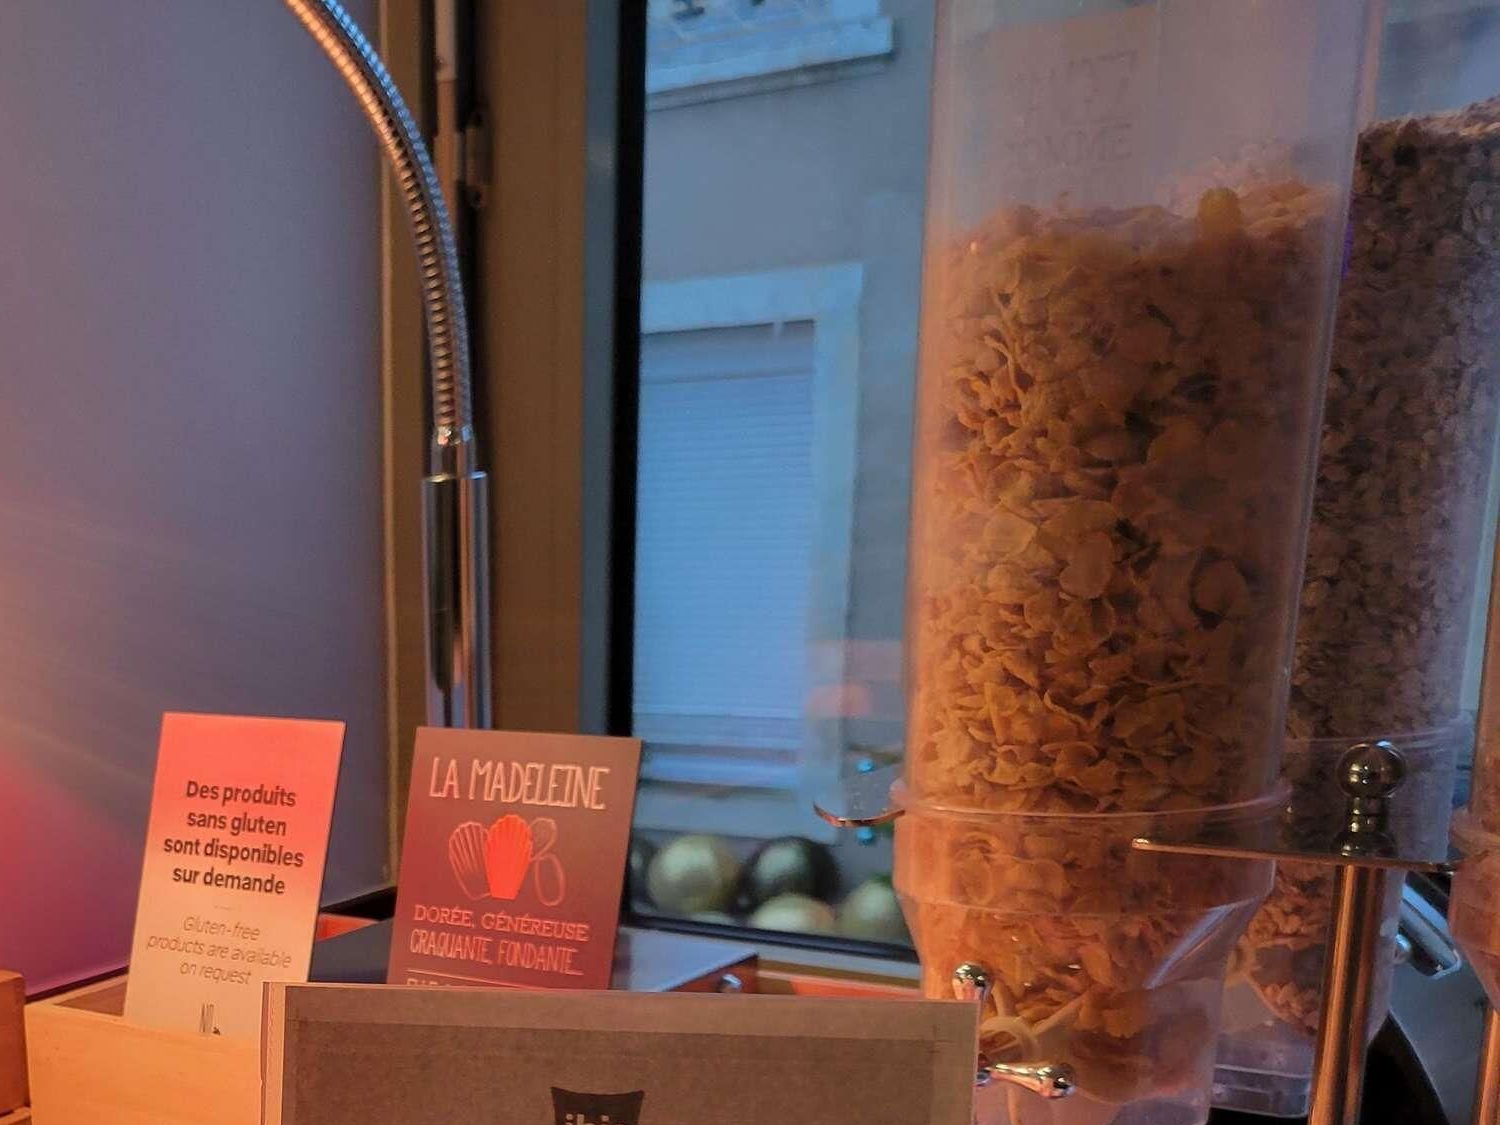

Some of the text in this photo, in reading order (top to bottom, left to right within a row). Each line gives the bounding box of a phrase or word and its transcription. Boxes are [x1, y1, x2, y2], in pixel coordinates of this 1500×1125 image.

[185, 780, 297, 807] Des produits
[429, 756, 610, 810] LA MADELEINE
[187, 811, 287, 836] sans gluten
[163, 837, 305, 868] sont disponibles
[172, 866, 286, 894] sur demande
[183, 916, 261, 941] Gluten-free
[481, 909, 590, 942] GÉNÉREUSE
[147, 934, 292, 969] products are available
[179, 962, 252, 985] on request
